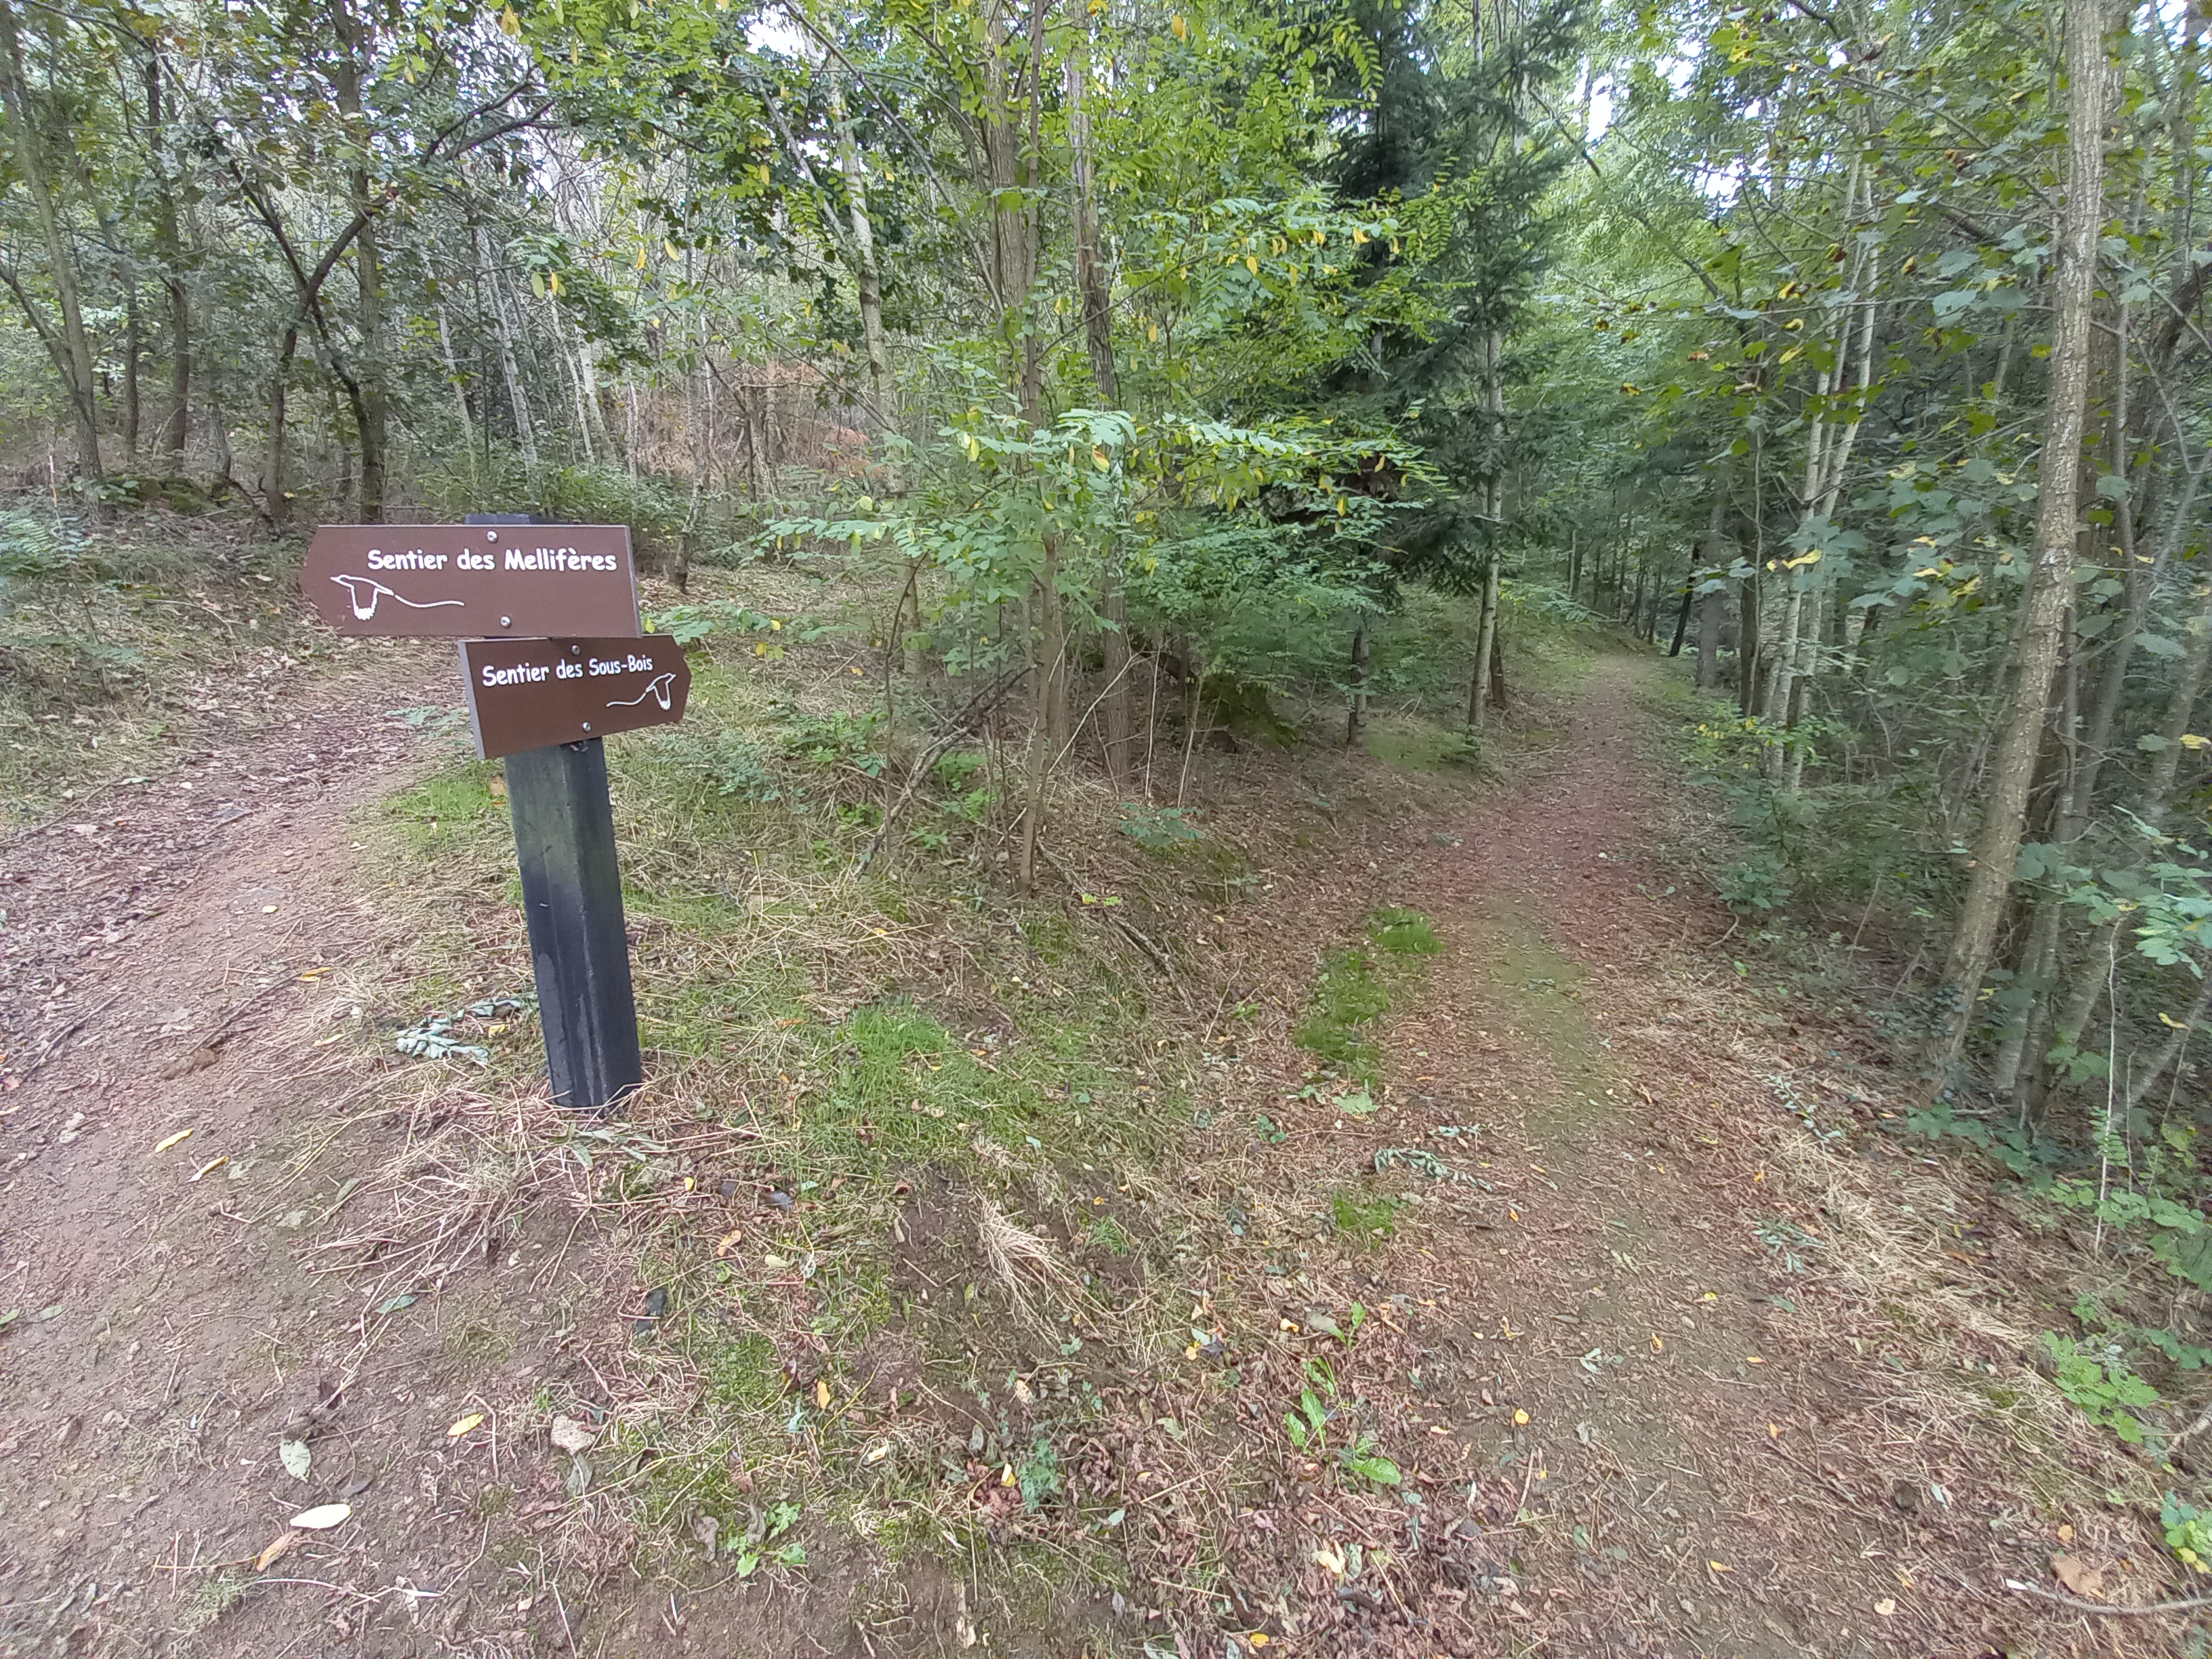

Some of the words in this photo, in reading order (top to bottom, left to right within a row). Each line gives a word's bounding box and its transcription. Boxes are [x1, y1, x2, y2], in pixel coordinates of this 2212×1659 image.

[367, 549, 448, 570] Sentier
[456, 548, 495, 570] des
[504, 547, 617, 572] Mellifères
[482, 662, 550, 687] Sentier
[556, 659, 583, 679] des
[589, 654, 653, 676] Sous-Bois
